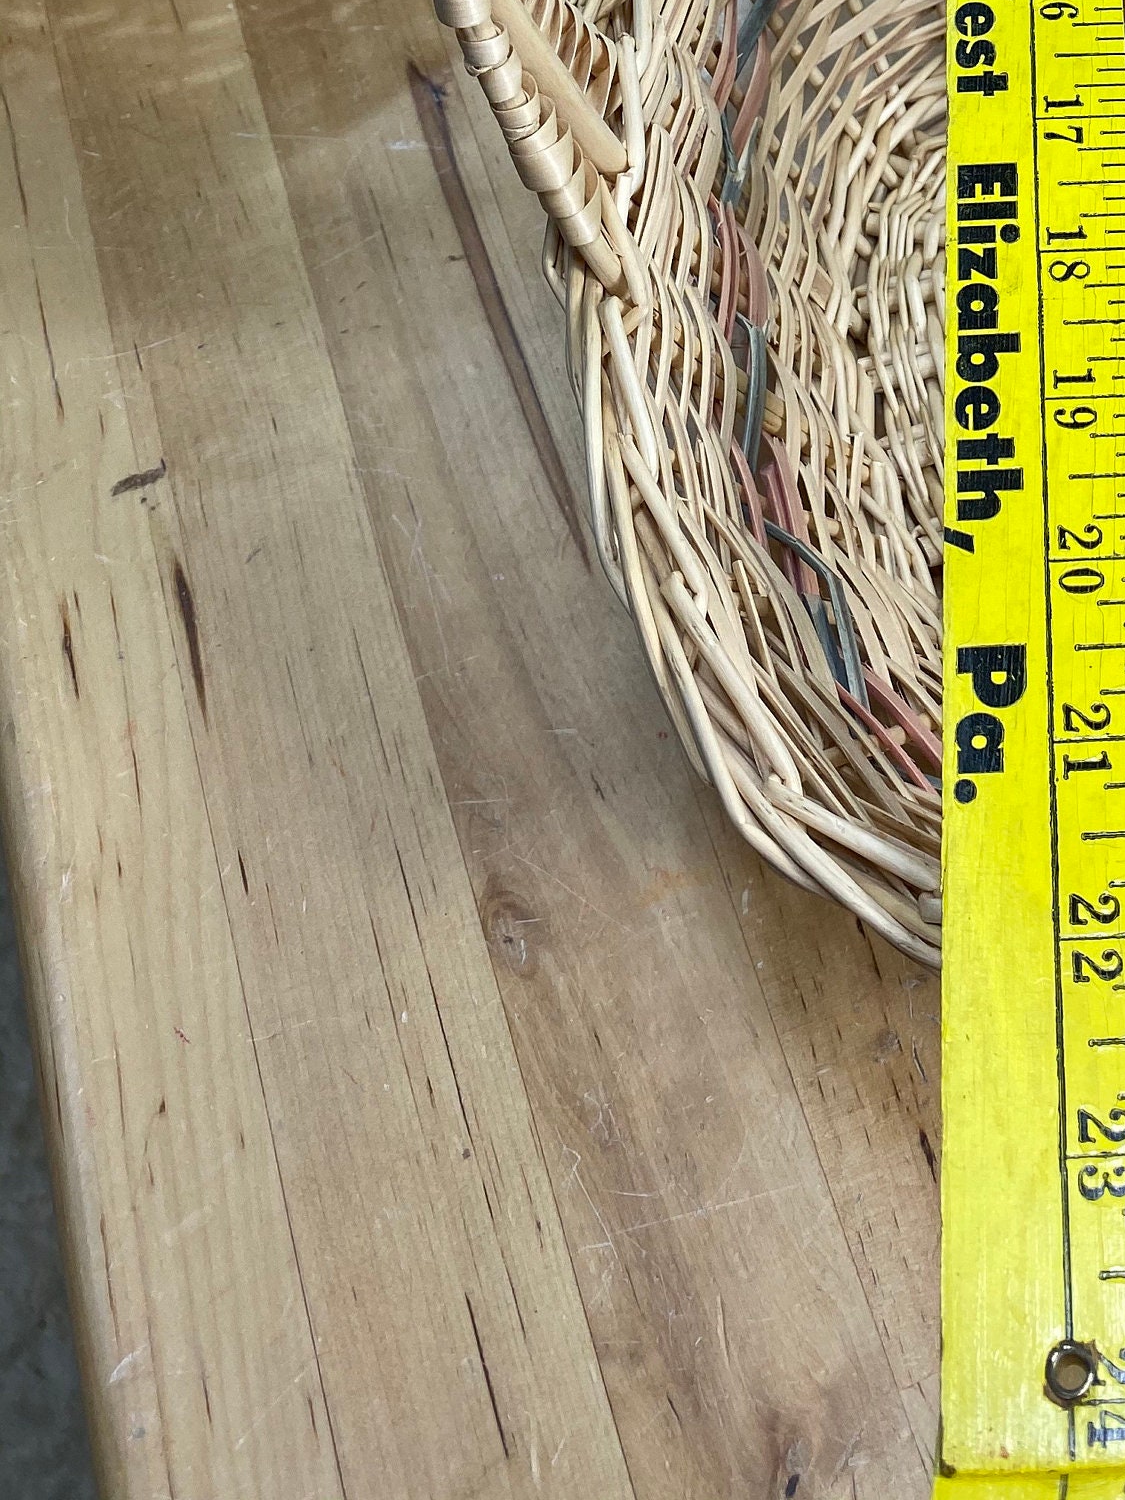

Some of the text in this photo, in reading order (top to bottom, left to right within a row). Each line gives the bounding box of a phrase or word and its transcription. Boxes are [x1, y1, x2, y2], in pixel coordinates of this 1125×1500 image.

[1043, 94, 1084, 144] 17
[1045, 225, 1091, 282] 18
[944, 161, 1024, 554] Elizabeth,
[1052, 368, 1098, 430] 19
[1057, 524, 1105, 595] 20
[953, 643, 1028, 805] Pa.
[1061, 703, 1112, 781] 21
[1068, 893, 1124, 984] 22
